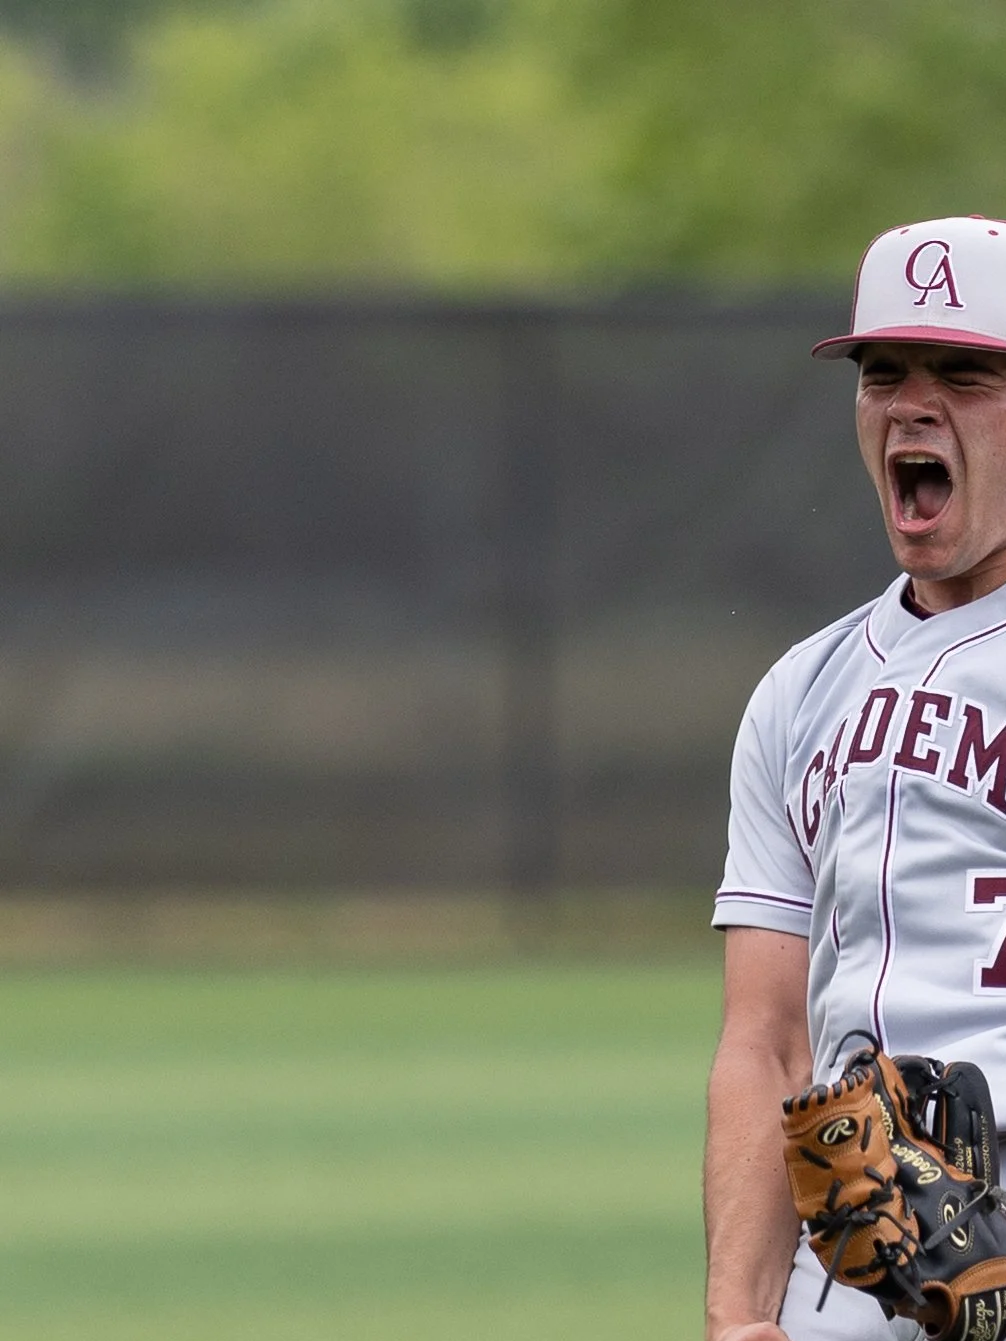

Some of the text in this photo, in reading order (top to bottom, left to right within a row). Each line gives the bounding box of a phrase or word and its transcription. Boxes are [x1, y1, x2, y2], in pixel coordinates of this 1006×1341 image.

[905, 240, 964, 308] CA
[823, 1118, 854, 1144] R
[891, 1143, 942, 1184] Cooper
